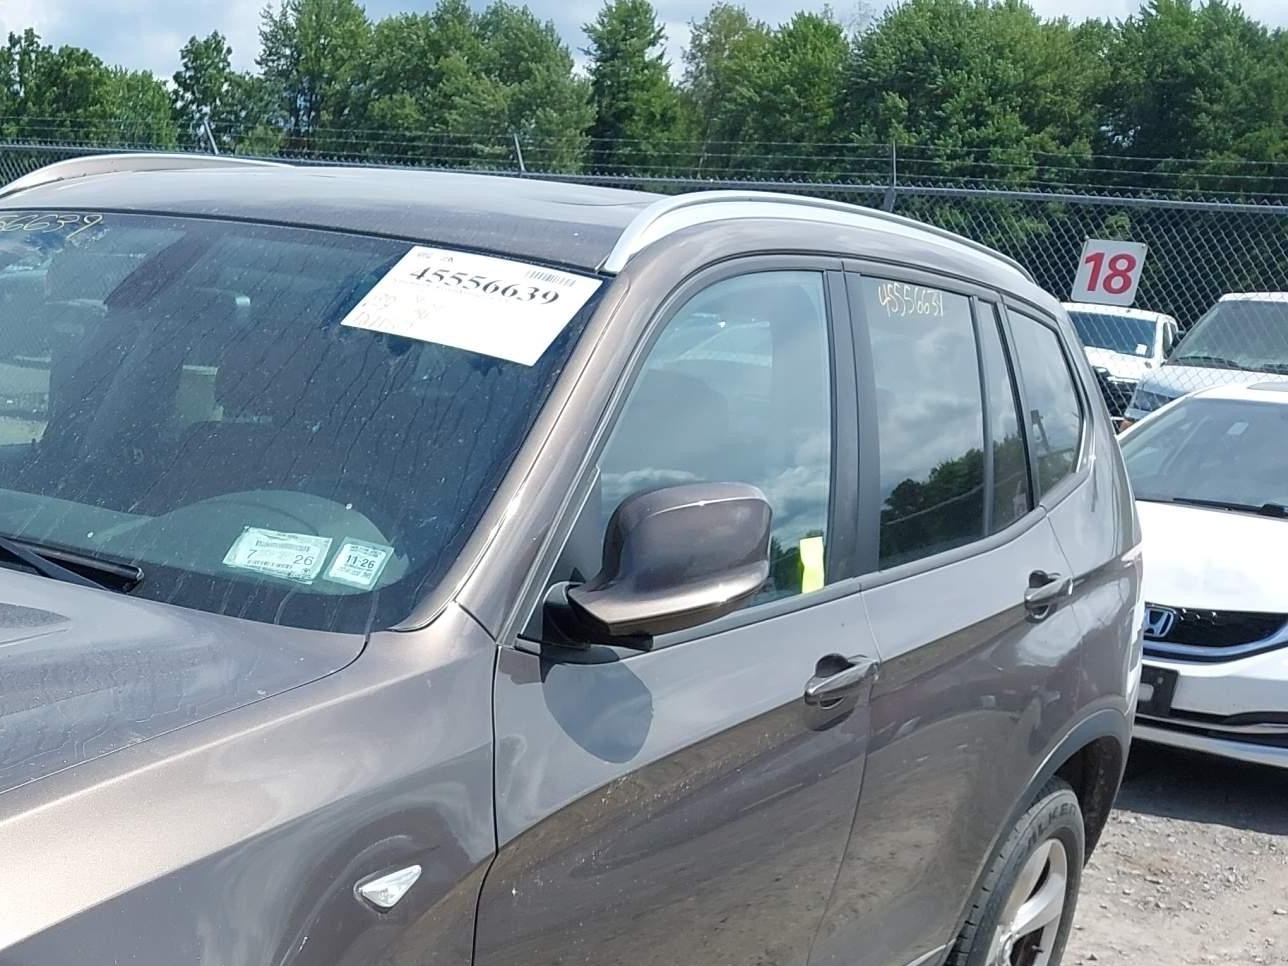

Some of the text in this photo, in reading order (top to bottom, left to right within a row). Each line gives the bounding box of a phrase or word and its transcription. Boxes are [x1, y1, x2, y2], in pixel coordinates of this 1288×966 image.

[409, 265, 561, 305] 45556639
[1084, 252, 1137, 295] 18
[293, 554, 314, 566] 26
